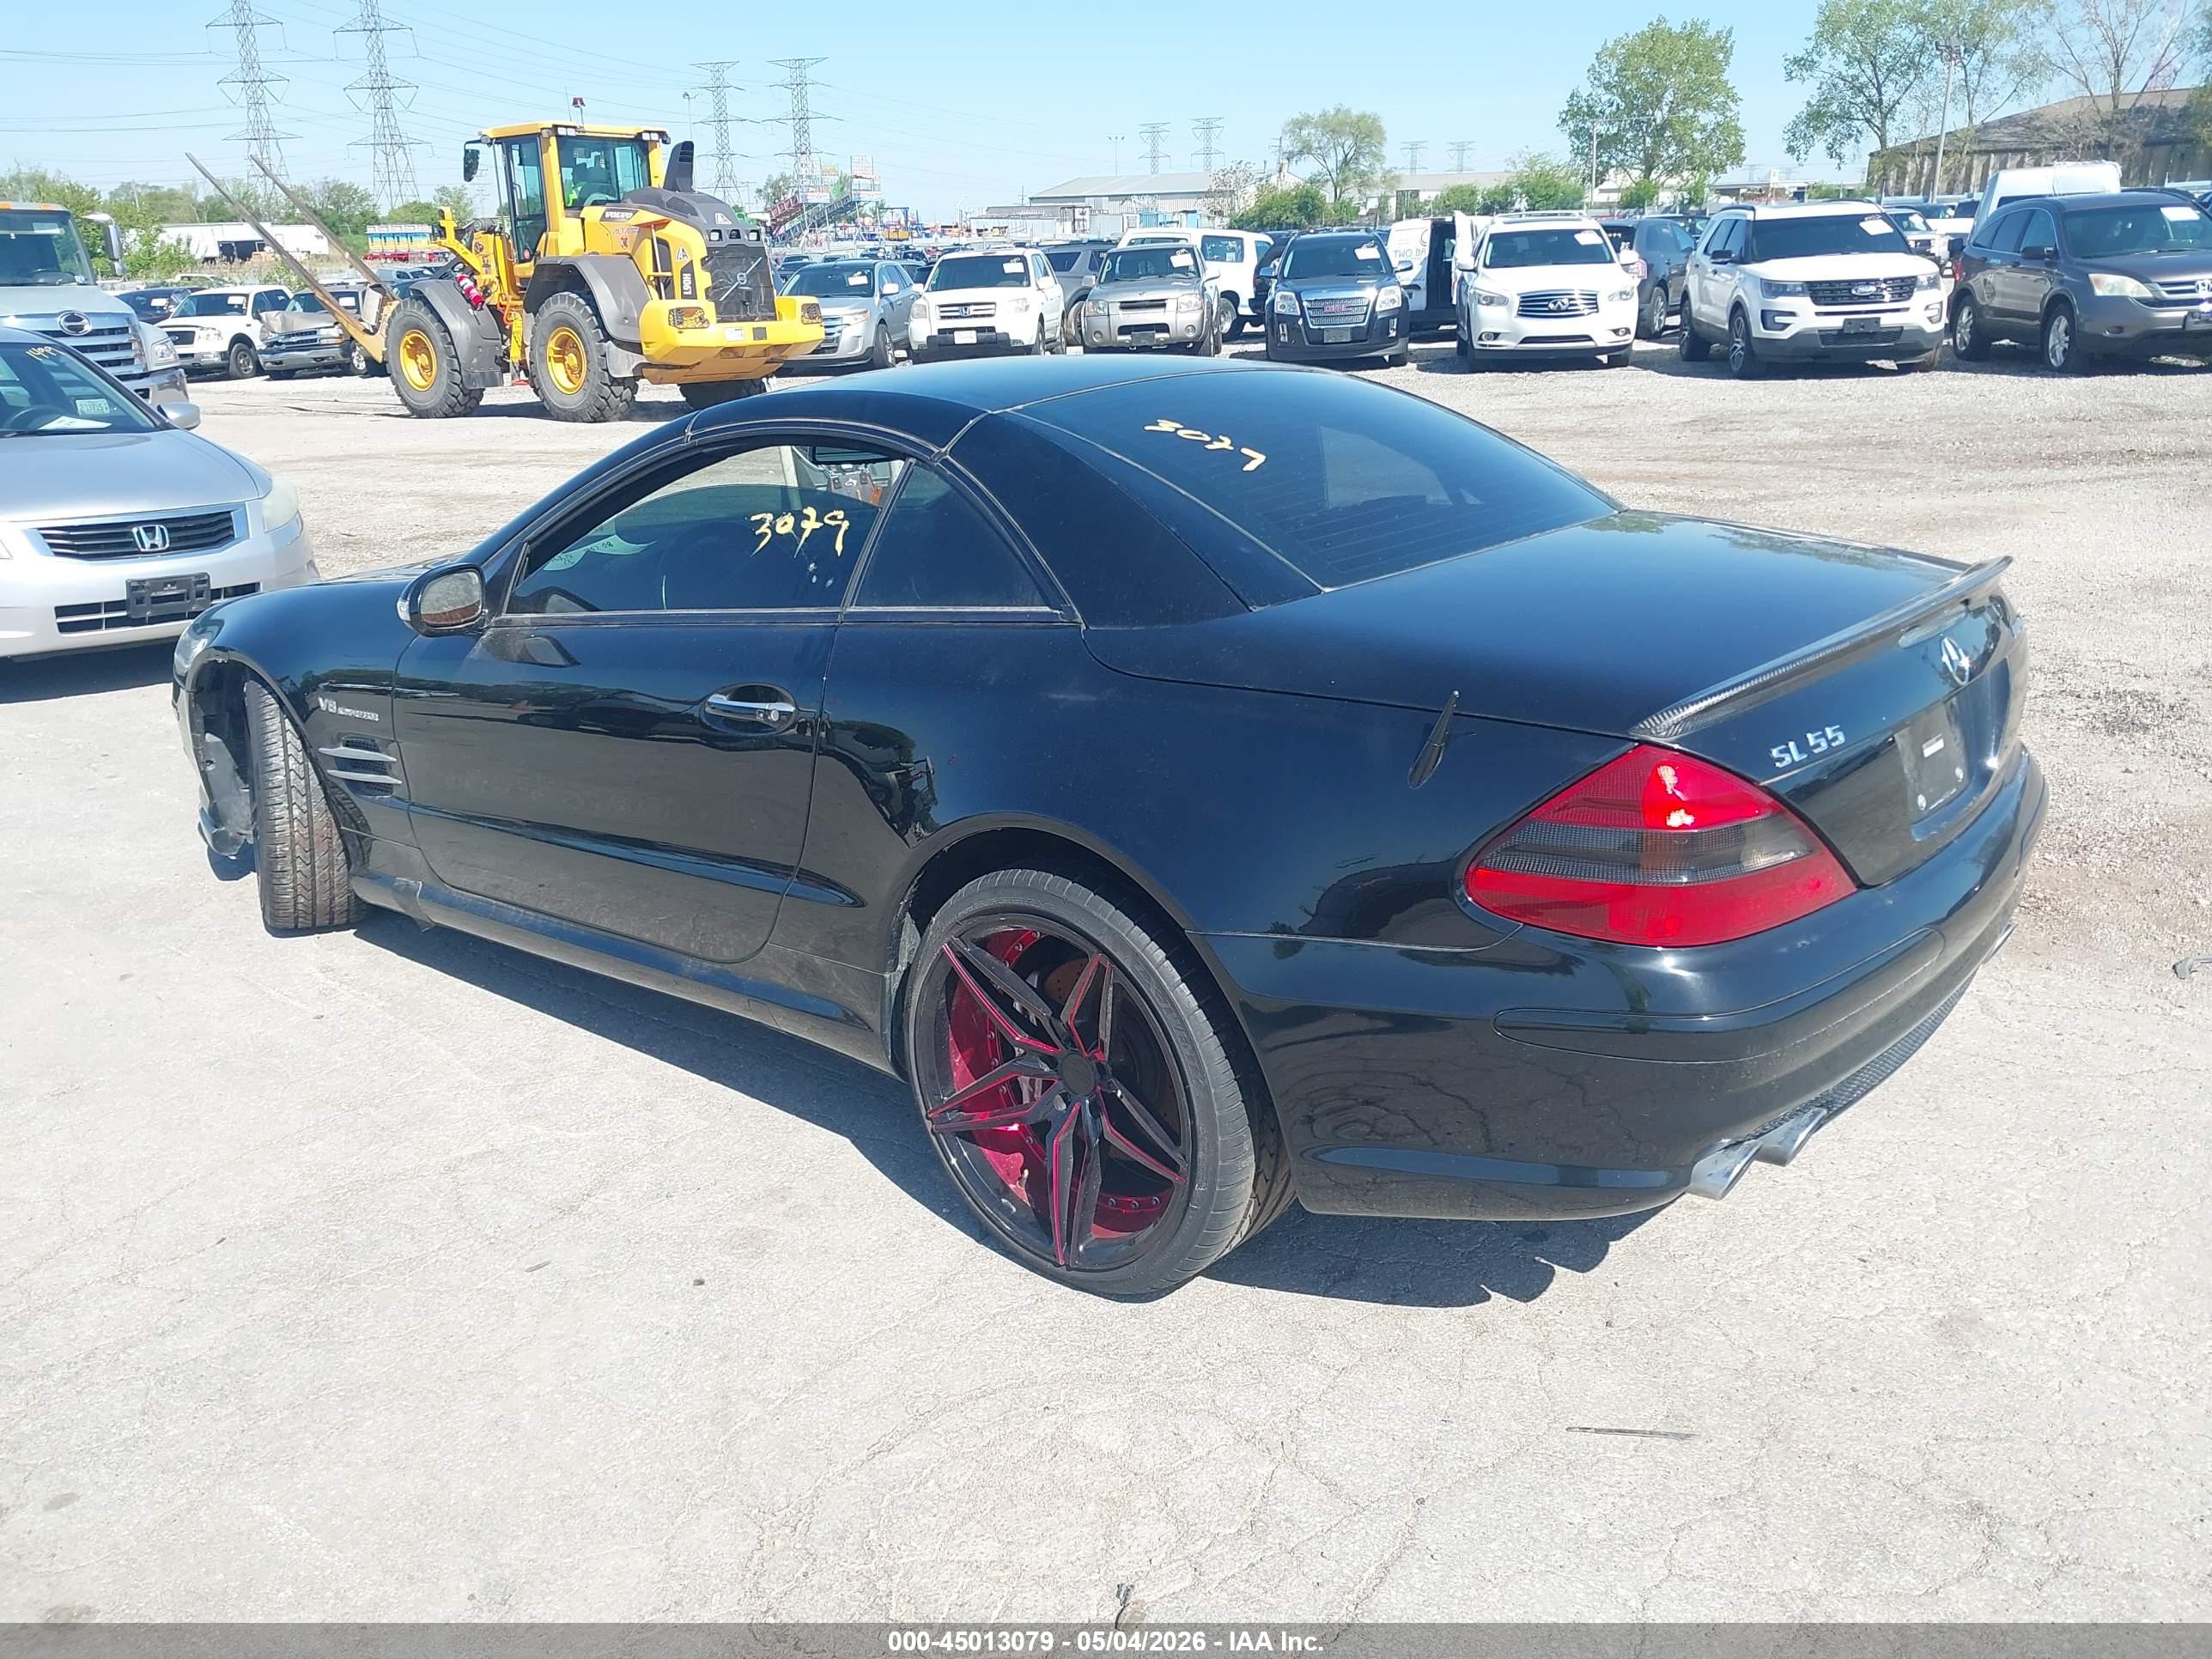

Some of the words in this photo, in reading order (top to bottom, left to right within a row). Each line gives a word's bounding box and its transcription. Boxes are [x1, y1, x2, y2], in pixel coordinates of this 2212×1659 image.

[1394, 248, 1413, 258] TWO
[683, 273, 692, 295] L90H
[318, 696, 337, 714] V8
[1771, 741, 1808, 769] SL
[1806, 725, 1846, 754] 55
